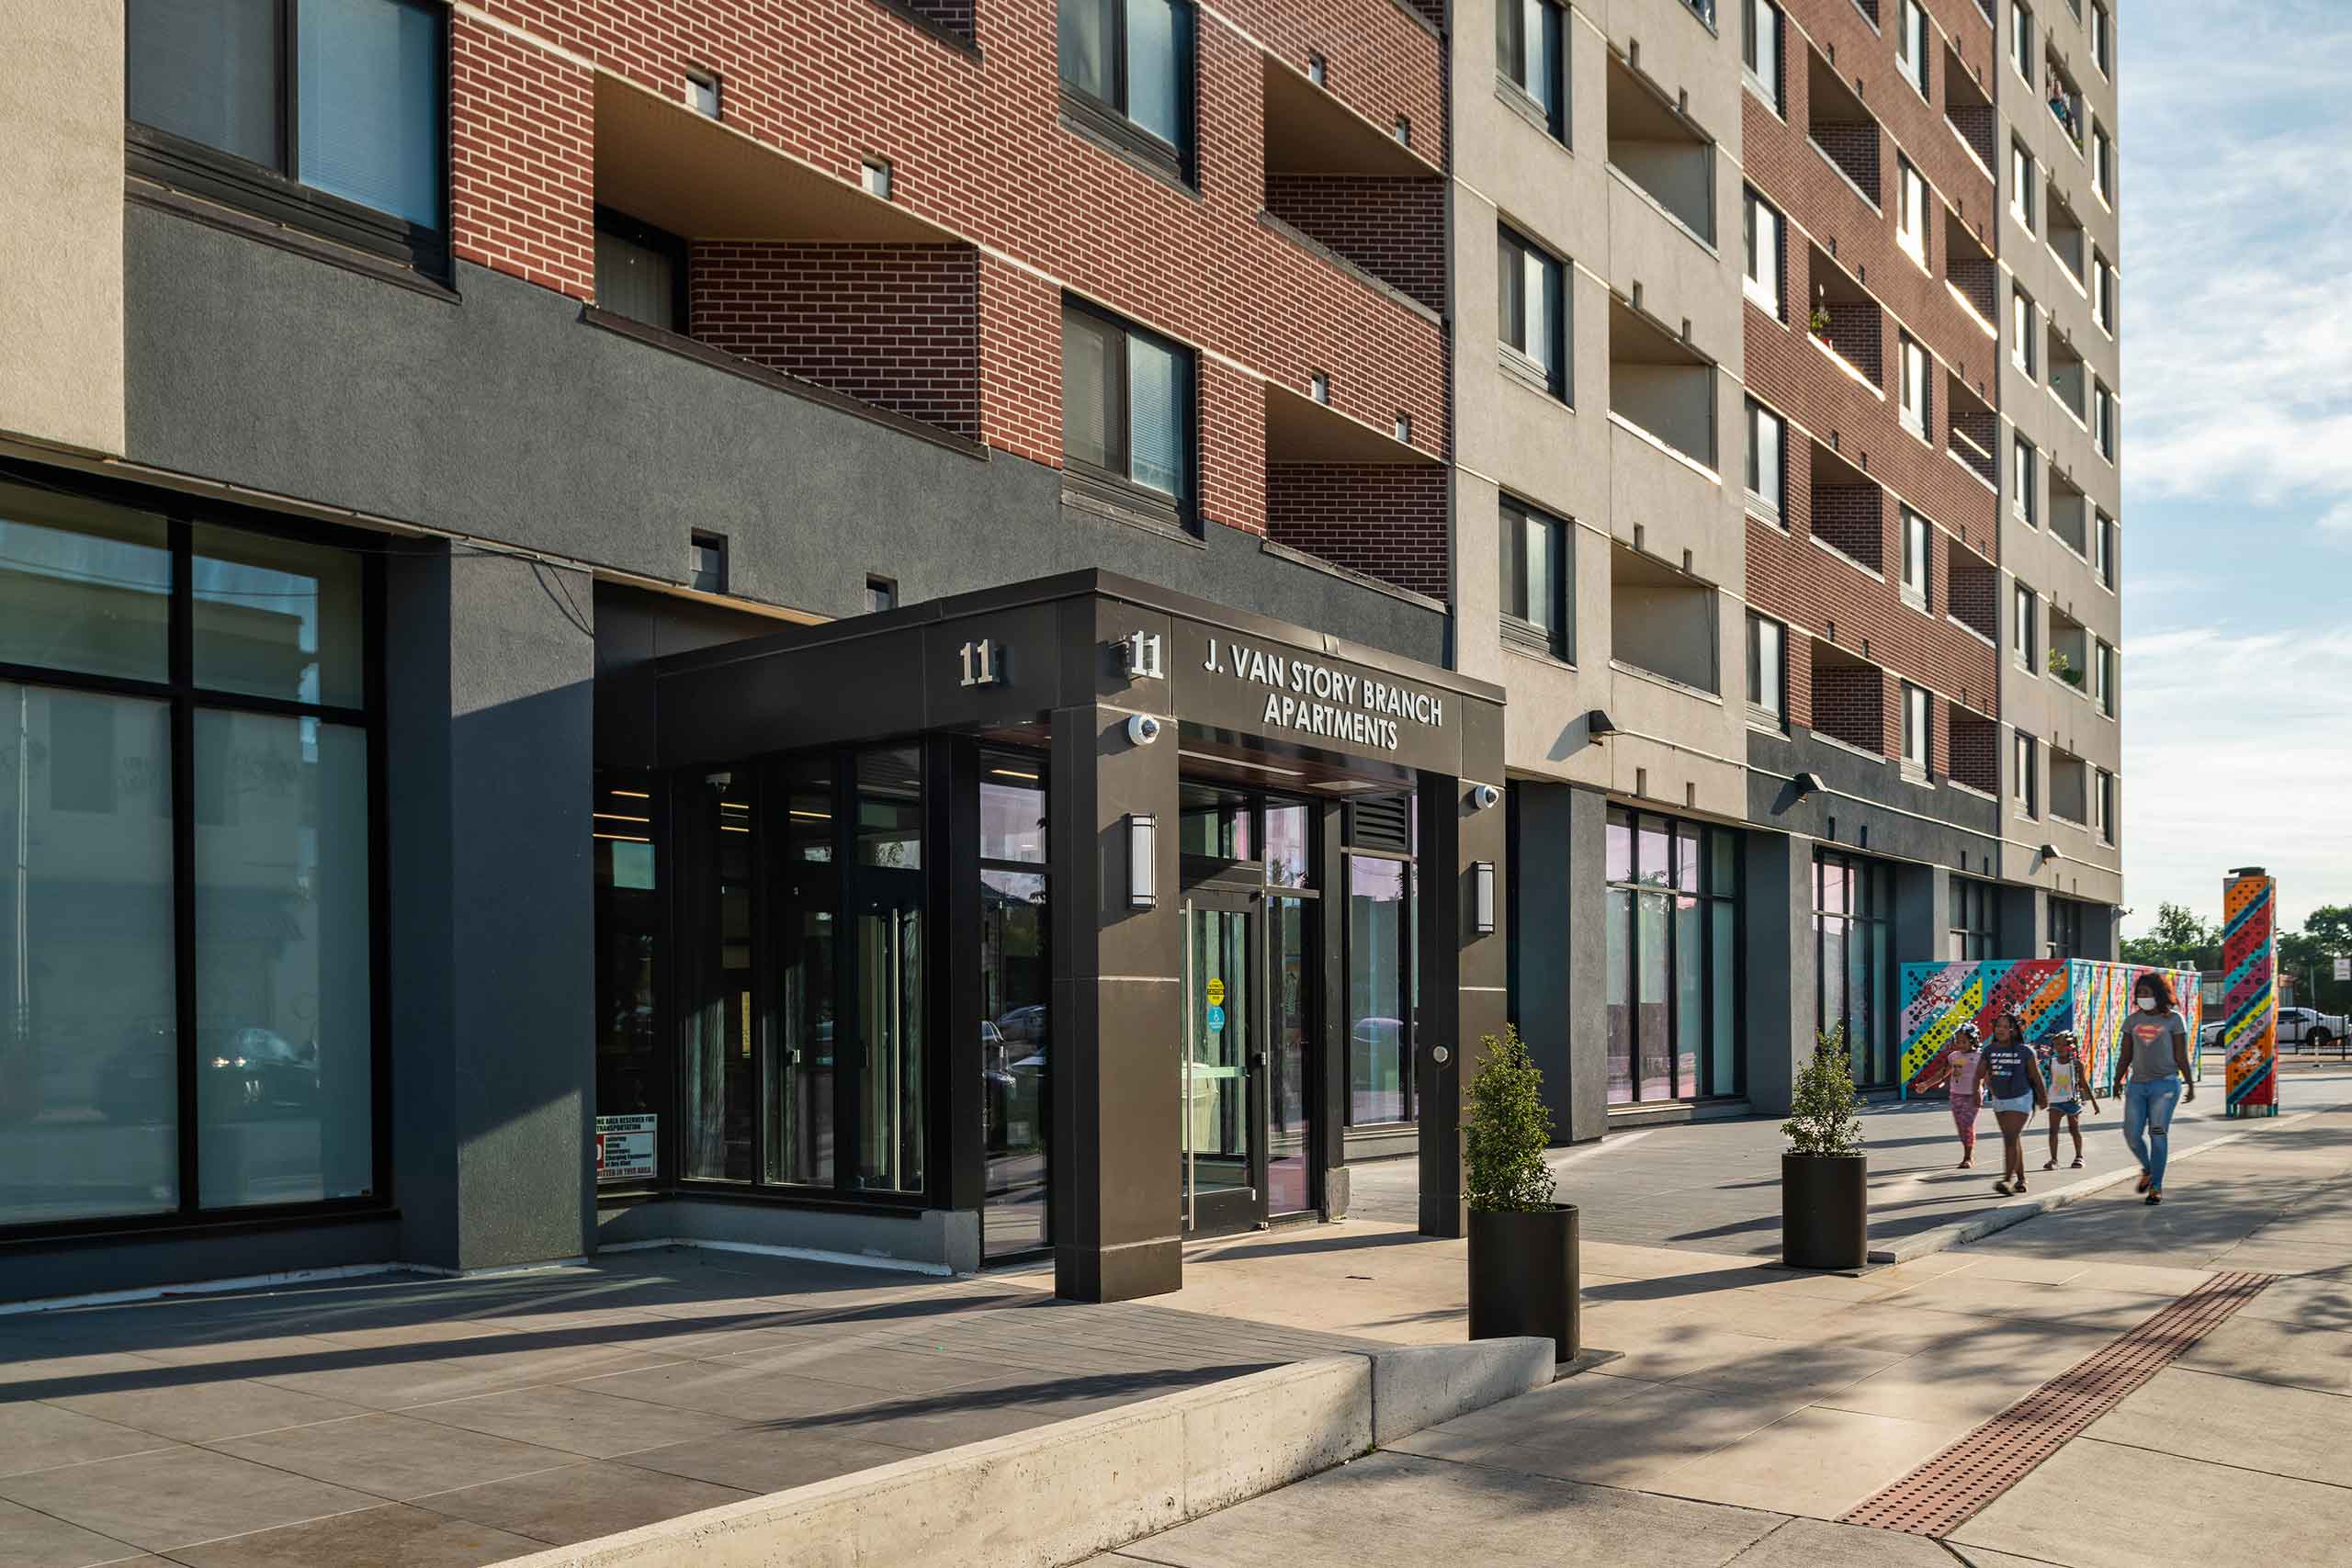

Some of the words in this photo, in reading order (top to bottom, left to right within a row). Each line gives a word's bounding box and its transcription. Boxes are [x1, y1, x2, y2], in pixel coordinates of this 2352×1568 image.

[960, 638, 993, 686] 11
[1131, 630, 1164, 681] 11
[1204, 638, 1225, 673] J.
[1231, 645, 1284, 688] VAN
[1290, 660, 1357, 705] STORY
[1363, 680, 1442, 727] BRANCH
[1263, 694, 1397, 750] APARTMENTS
